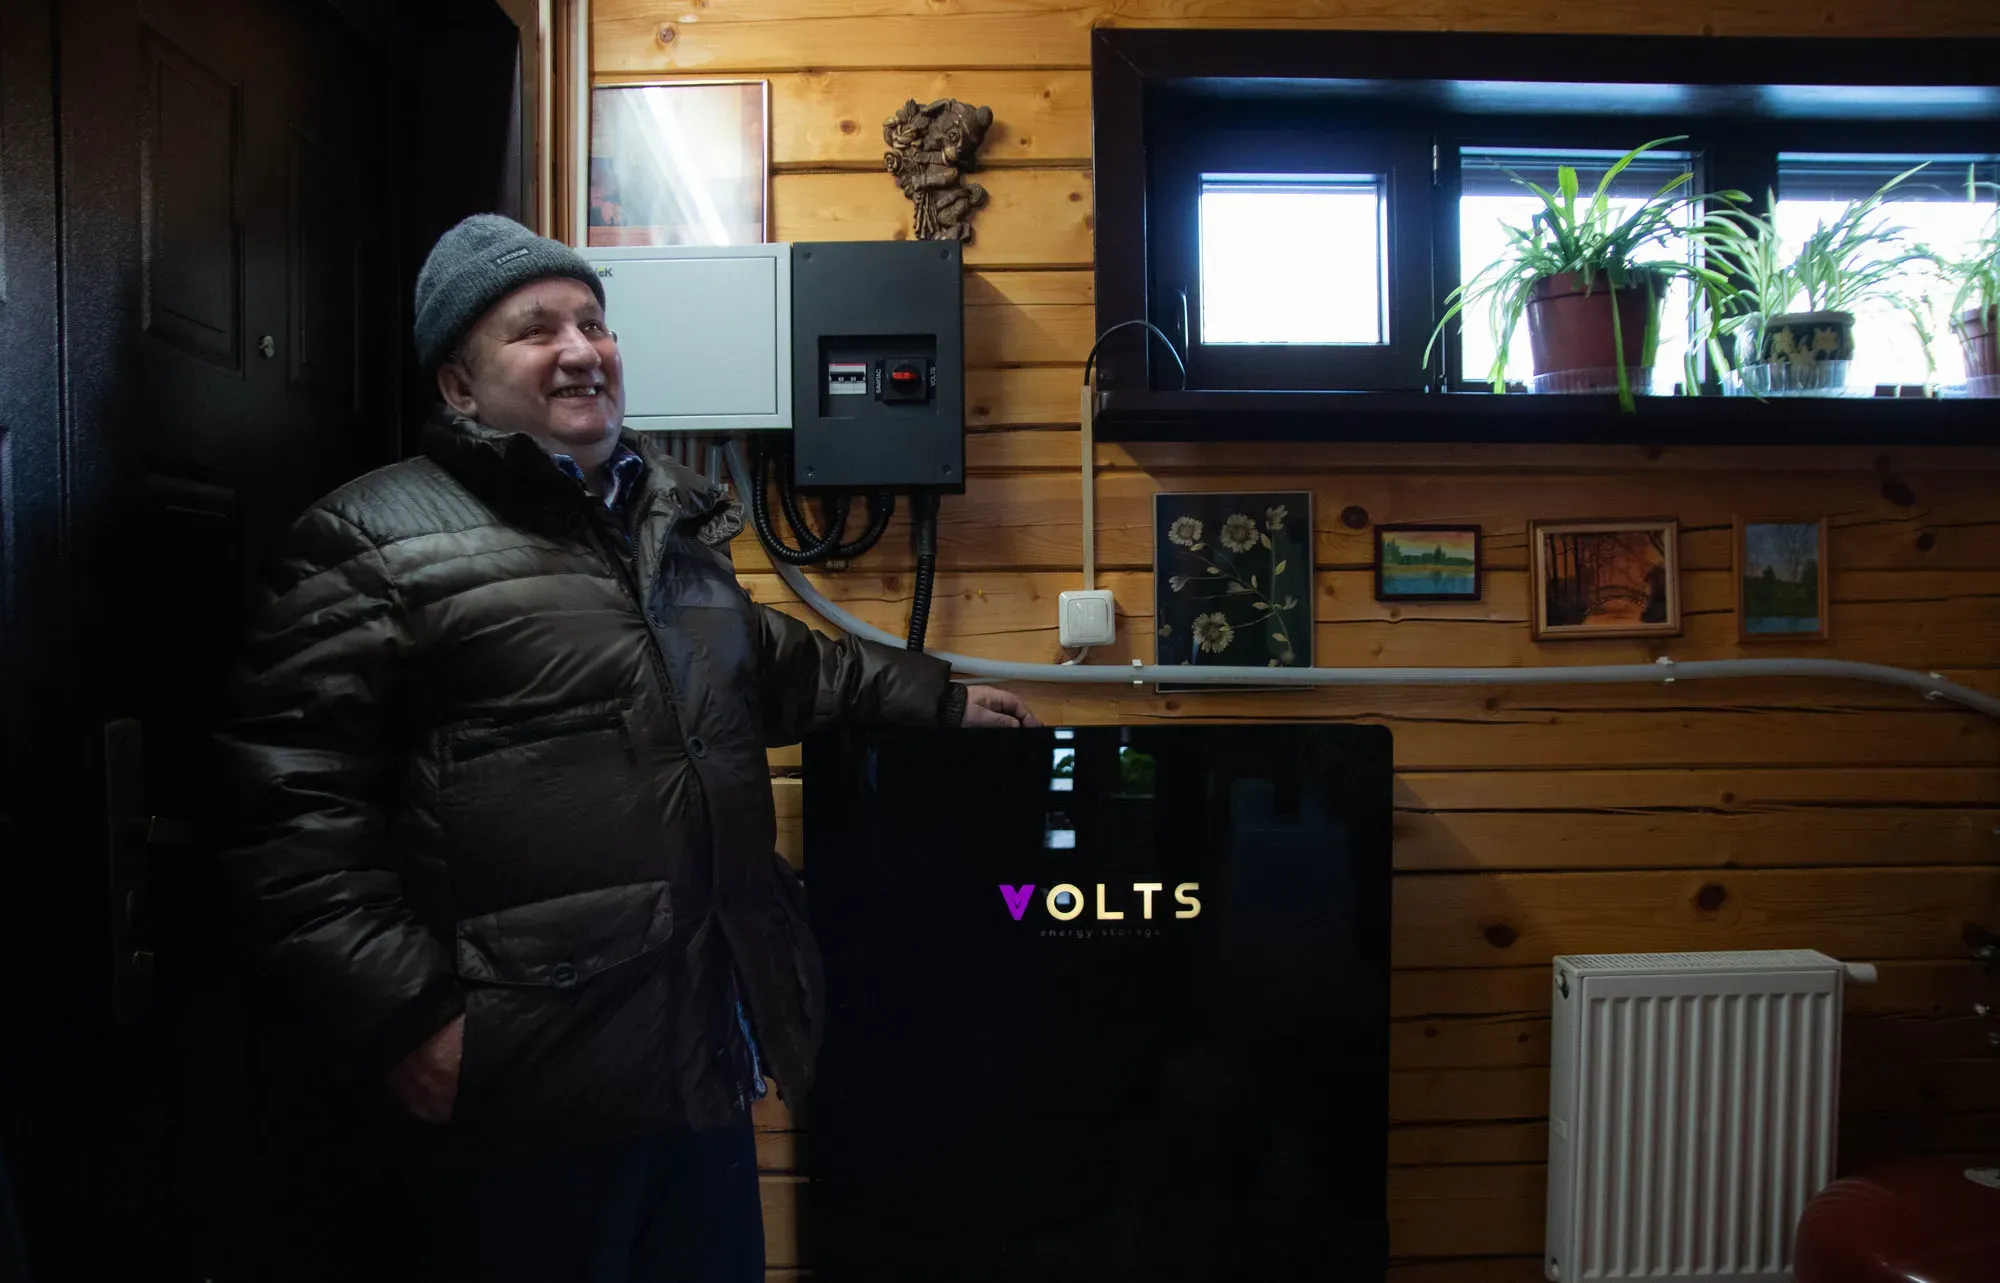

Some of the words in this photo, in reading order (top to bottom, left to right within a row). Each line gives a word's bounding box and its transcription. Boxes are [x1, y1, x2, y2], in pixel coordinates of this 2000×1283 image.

[999, 882, 1202, 921] VOLTS
[1039, 928, 1093, 939] energy
[1101, 928, 1161, 939] storage
